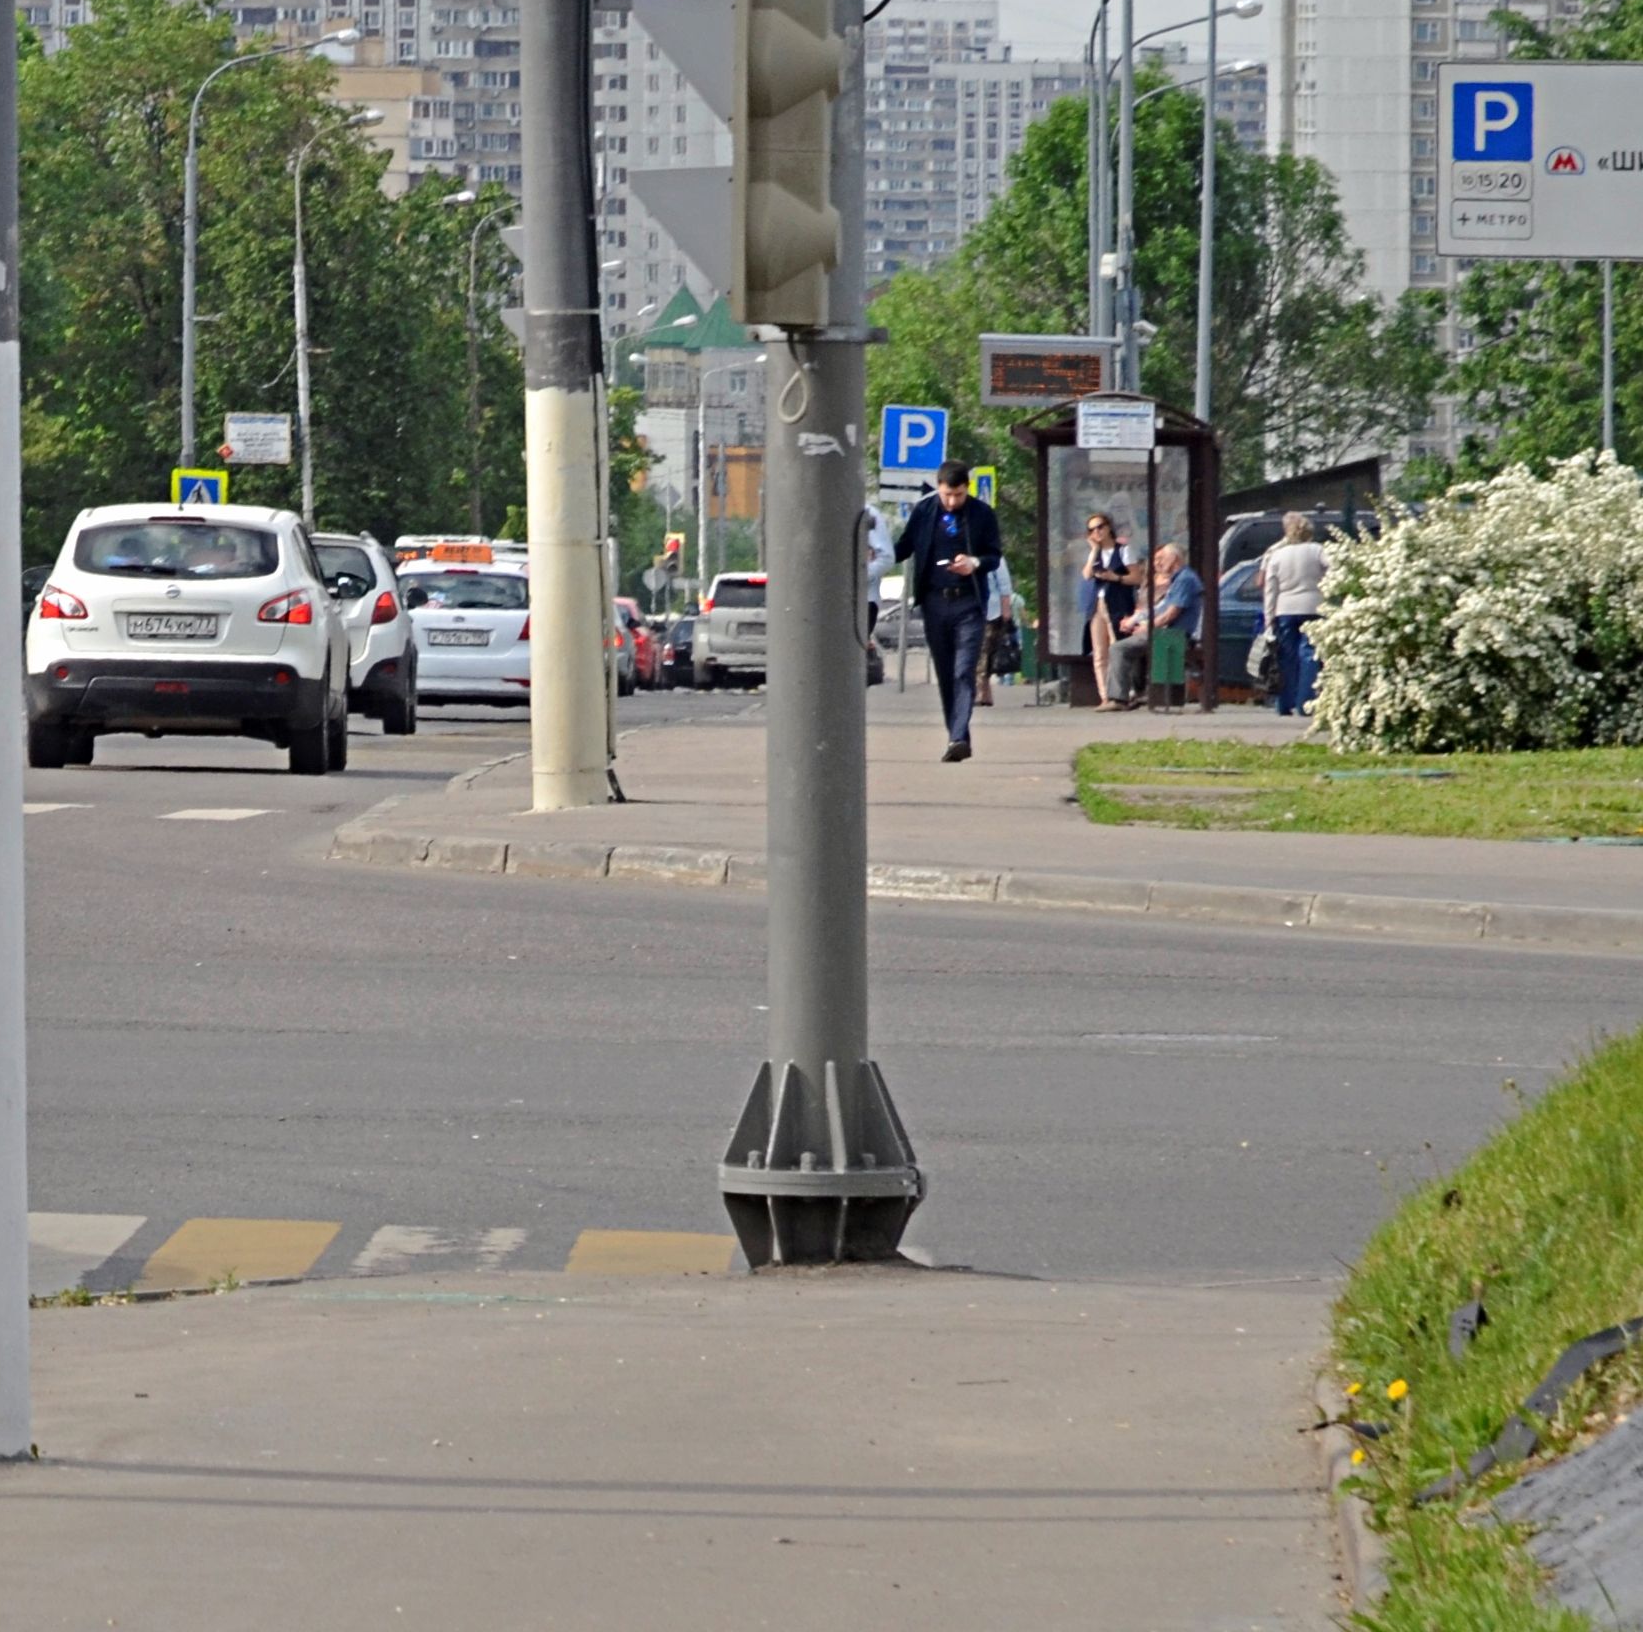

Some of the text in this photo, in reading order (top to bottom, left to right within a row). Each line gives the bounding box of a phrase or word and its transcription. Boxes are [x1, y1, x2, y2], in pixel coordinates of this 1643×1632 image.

[1474, 90, 1519, 152] P
[1598, 151, 1643, 171] «Ш
[1478, 174, 1492, 187] 15
[1499, 173, 1522, 188] 20
[1475, 213, 1527, 226] МЕТРО
[898, 414, 935, 464] P
